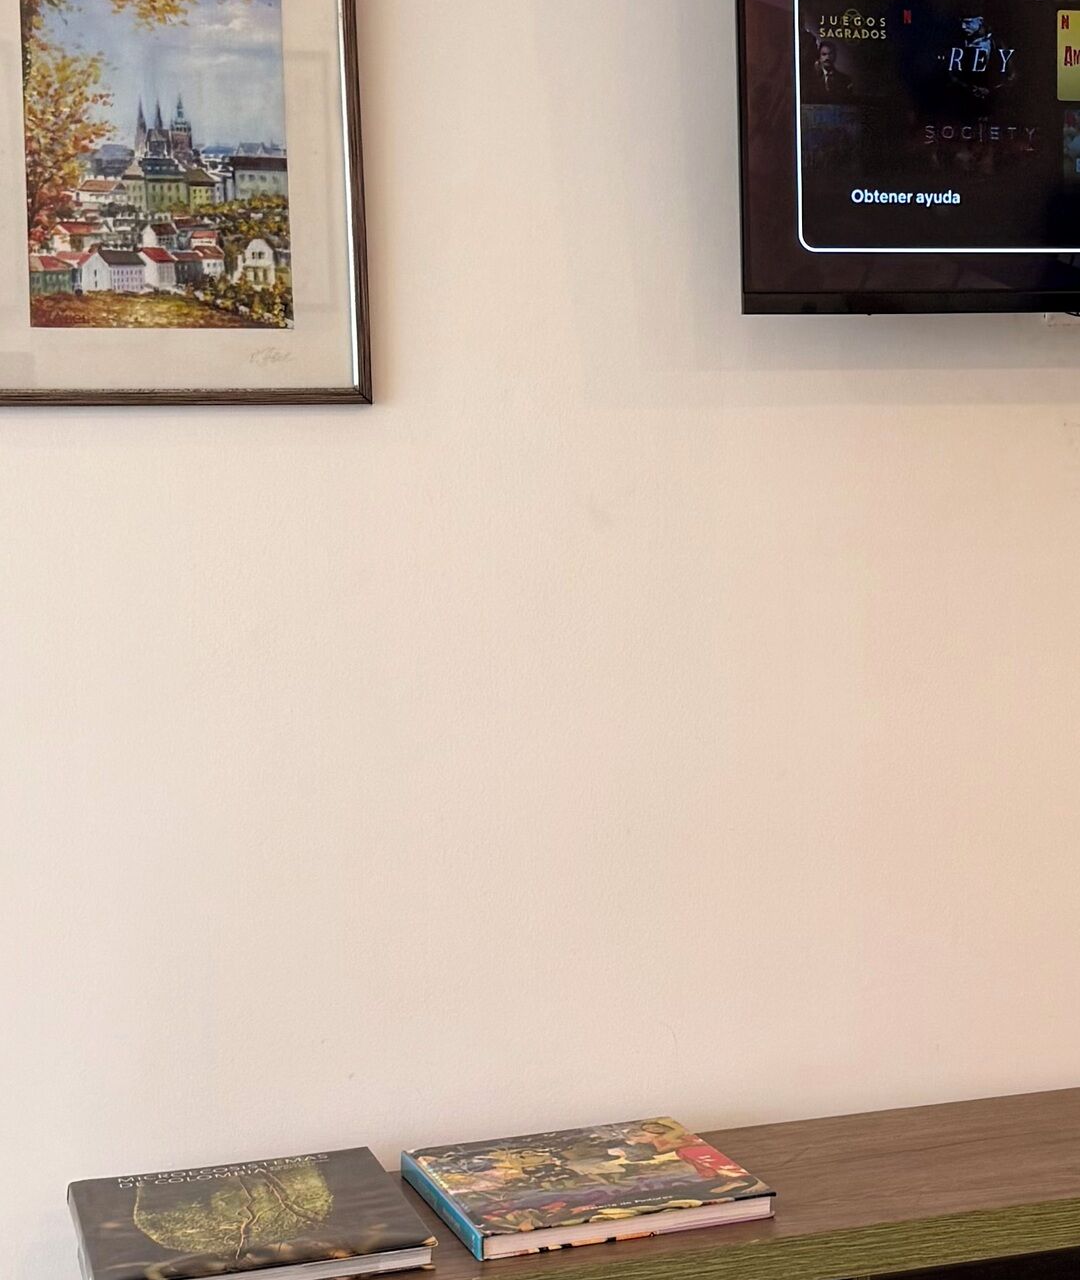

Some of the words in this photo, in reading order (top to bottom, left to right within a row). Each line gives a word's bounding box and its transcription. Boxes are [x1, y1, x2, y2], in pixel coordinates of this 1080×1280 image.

[820, 15, 887, 27] JUEGOS
[819, 28, 887, 40] SAGRADOS
[948, 47, 1015, 73] REY
[924, 125, 1036, 144] SOCIETY
[851, 189, 913, 204] Obtener
[915, 190, 961, 207] ayuda
[155, 1167, 268, 1185] COLOMBIA
